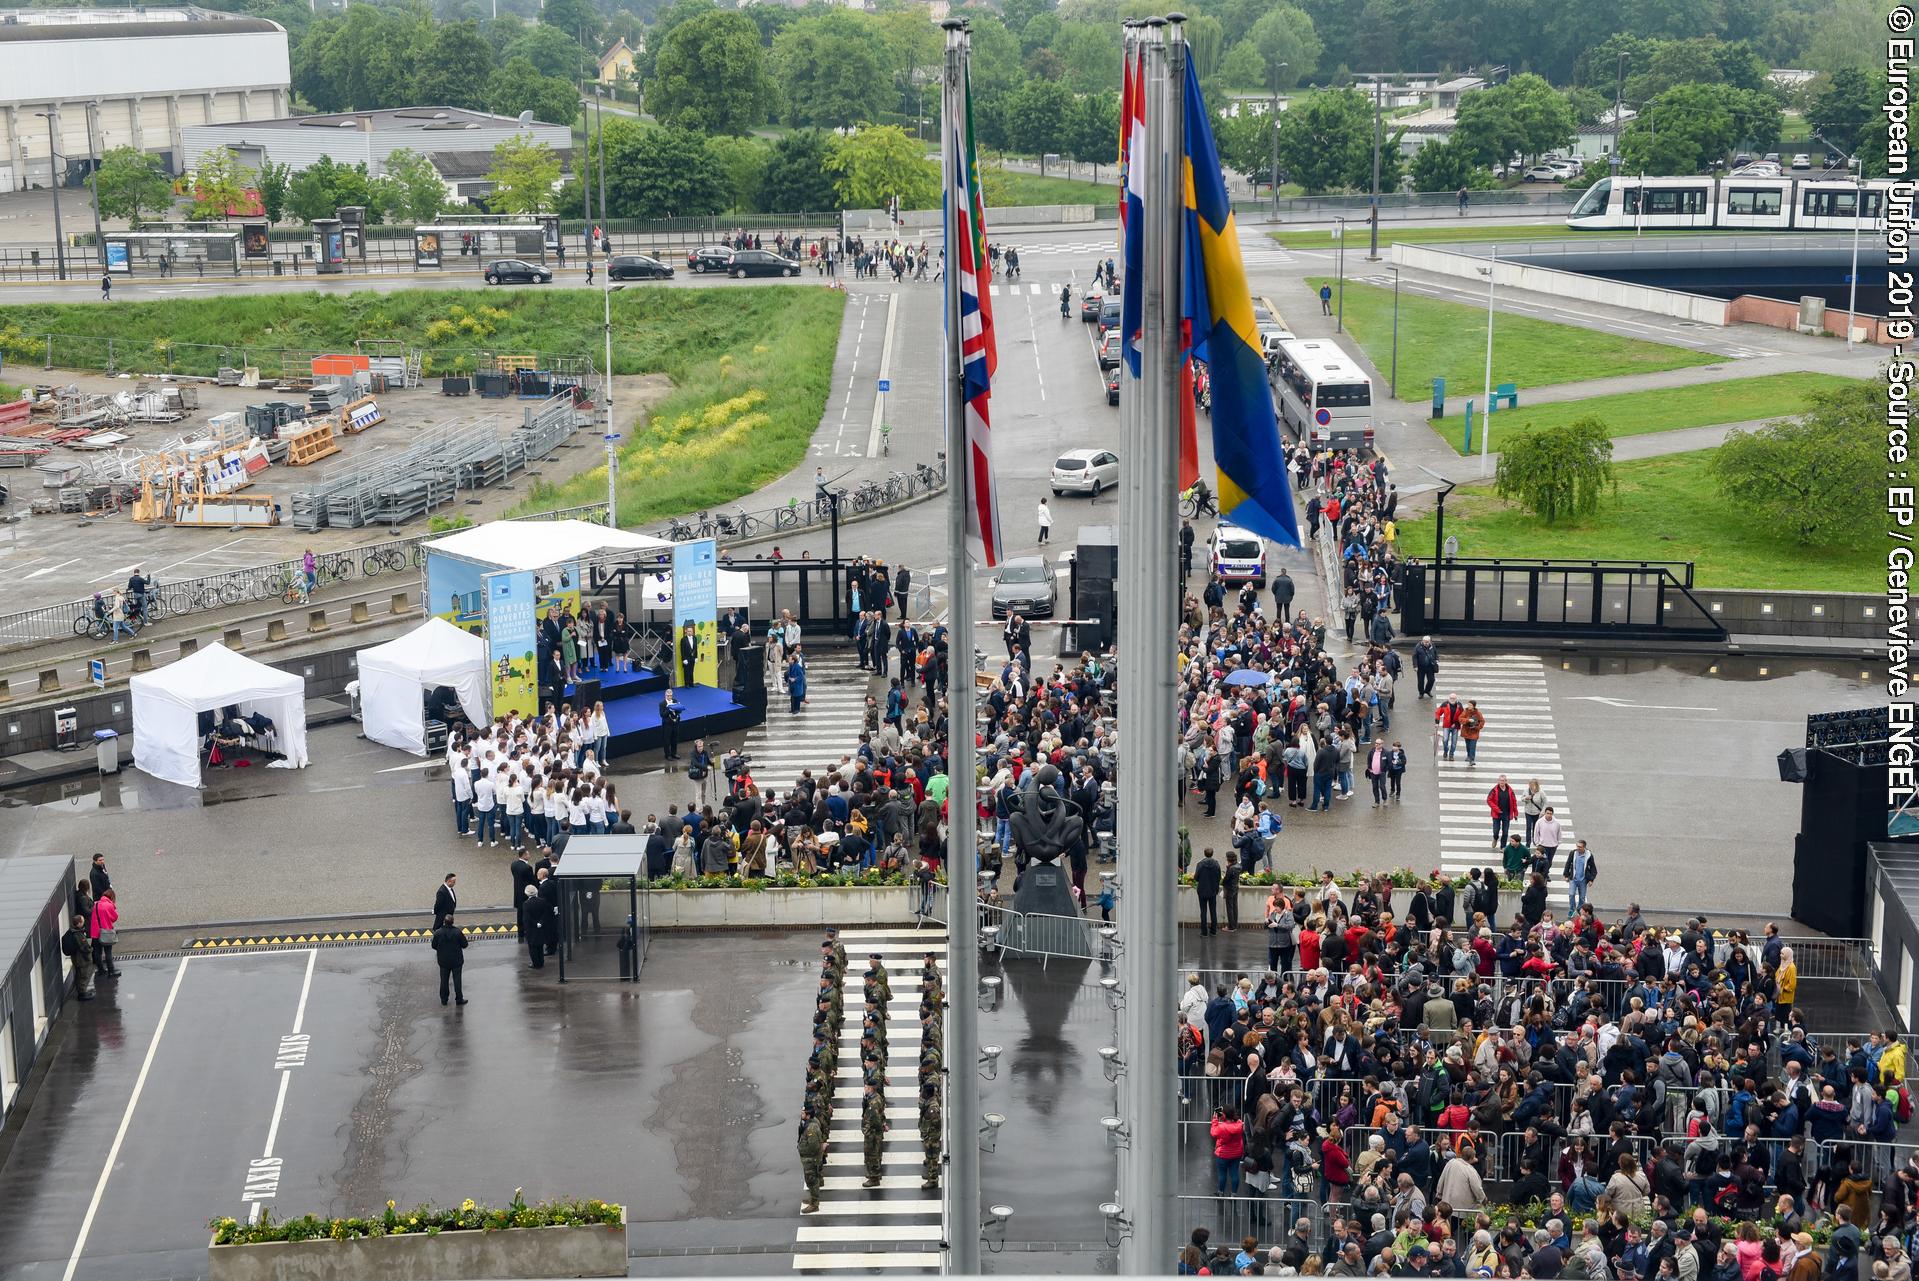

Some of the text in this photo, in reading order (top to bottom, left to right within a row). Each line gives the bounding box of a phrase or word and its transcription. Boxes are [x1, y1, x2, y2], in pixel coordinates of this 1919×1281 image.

[492, 601, 531, 614] PORTES
[493, 610, 531, 624] OUVERTES
[274, 1034, 311, 1069] TAXIS
[241, 1157, 284, 1201] TAXIS
